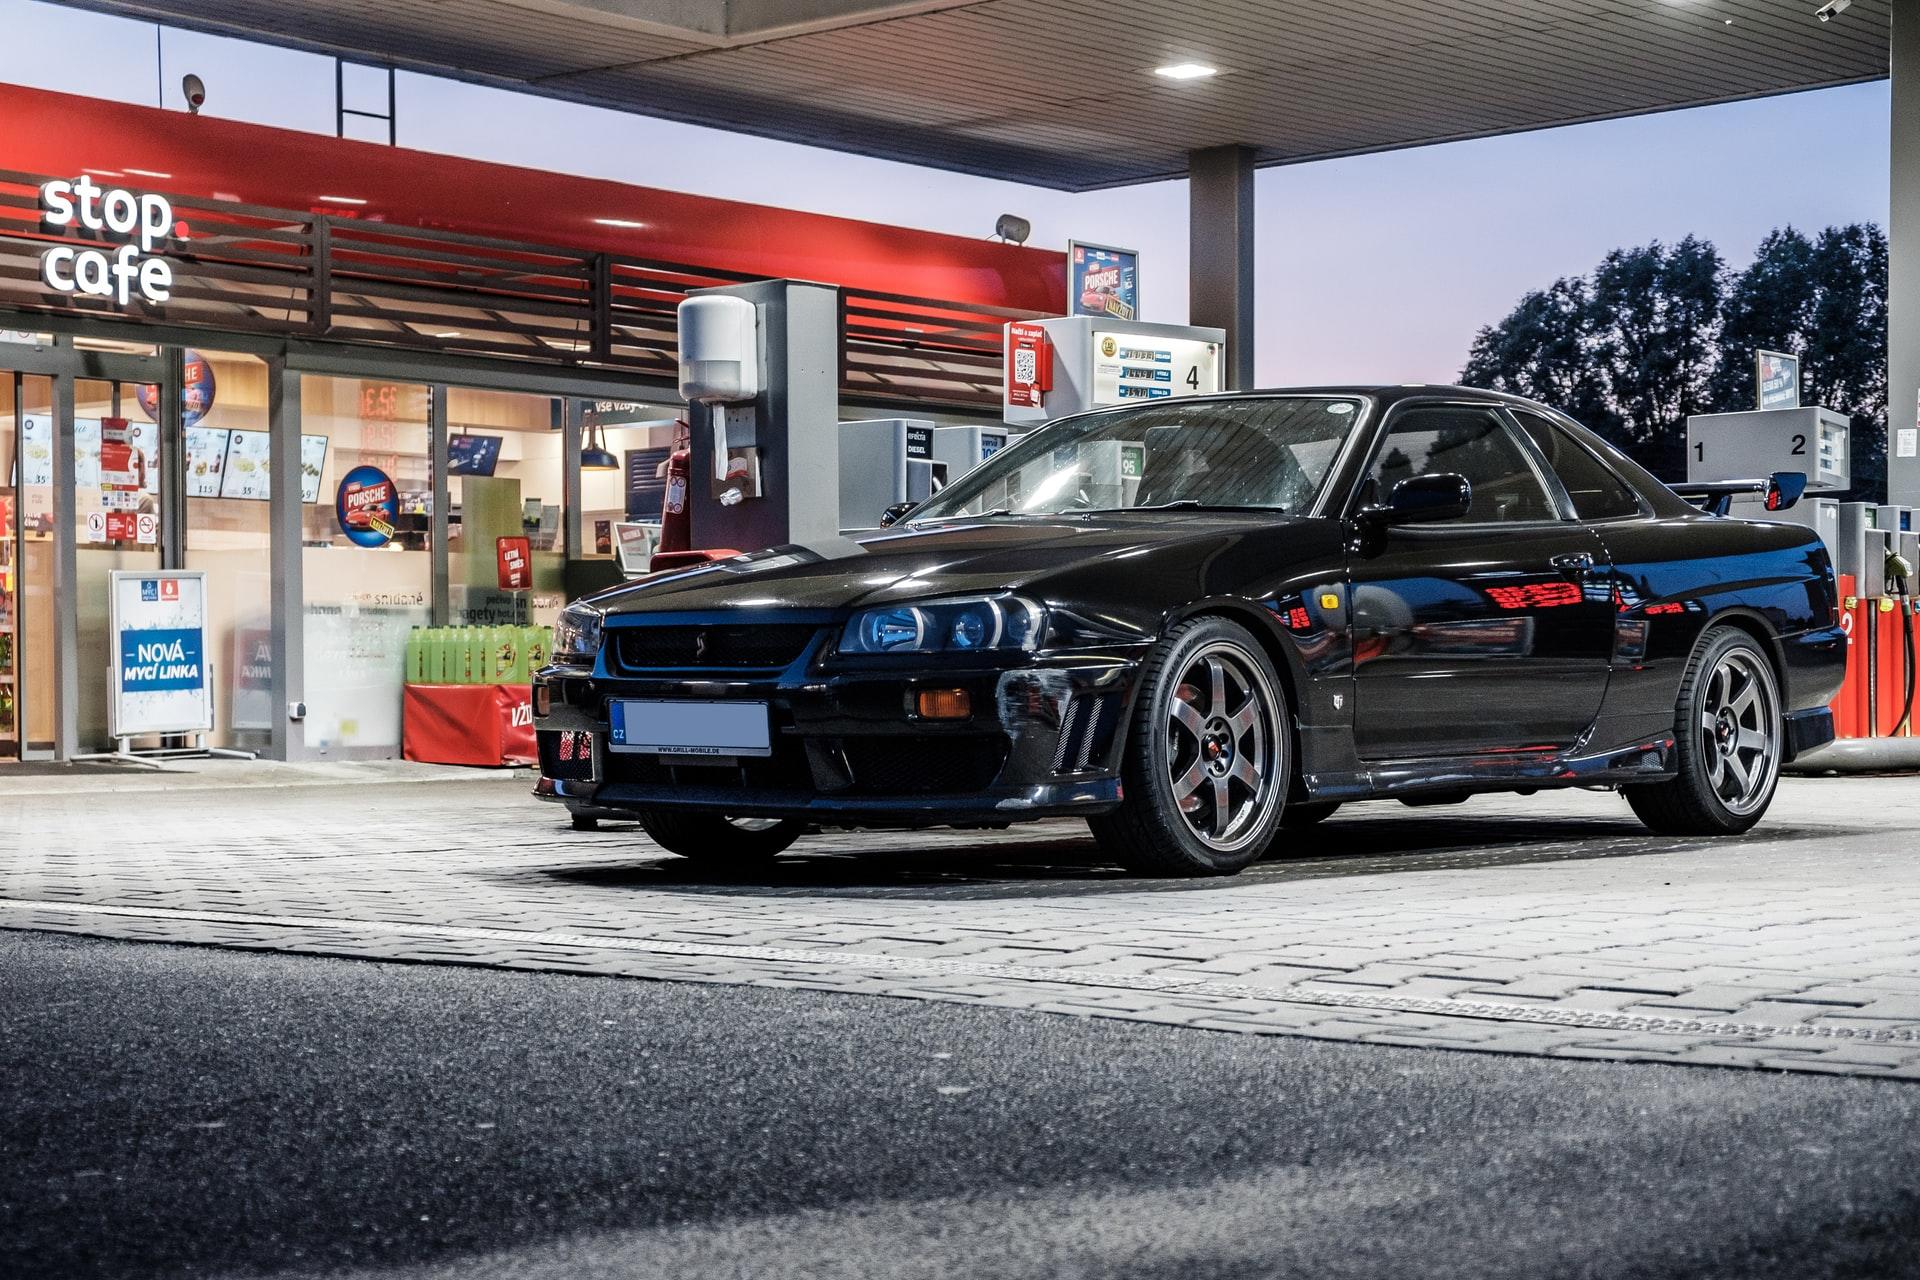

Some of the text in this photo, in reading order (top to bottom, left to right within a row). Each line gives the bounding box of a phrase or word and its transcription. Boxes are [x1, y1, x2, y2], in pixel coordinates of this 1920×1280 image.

[45, 245, 173, 306] cafe
[1085, 270, 1119, 290] PORSCHE
[1186, 365, 1199, 390] 4
[908, 446, 926, 454] DIESEL
[1694, 442, 1704, 463] 1
[1791, 434, 1806, 455] 2
[1123, 459, 1135, 474] 95
[198, 485, 213, 494] 115
[348, 485, 387, 508] PORSCHE
[460, 606, 496, 624] agety
[138, 638, 185, 663] NOVÁ
[125, 663, 198, 680] MYCÍ LINKA
[511, 701, 533, 728] VŽD
[613, 729, 625, 739] CZ
